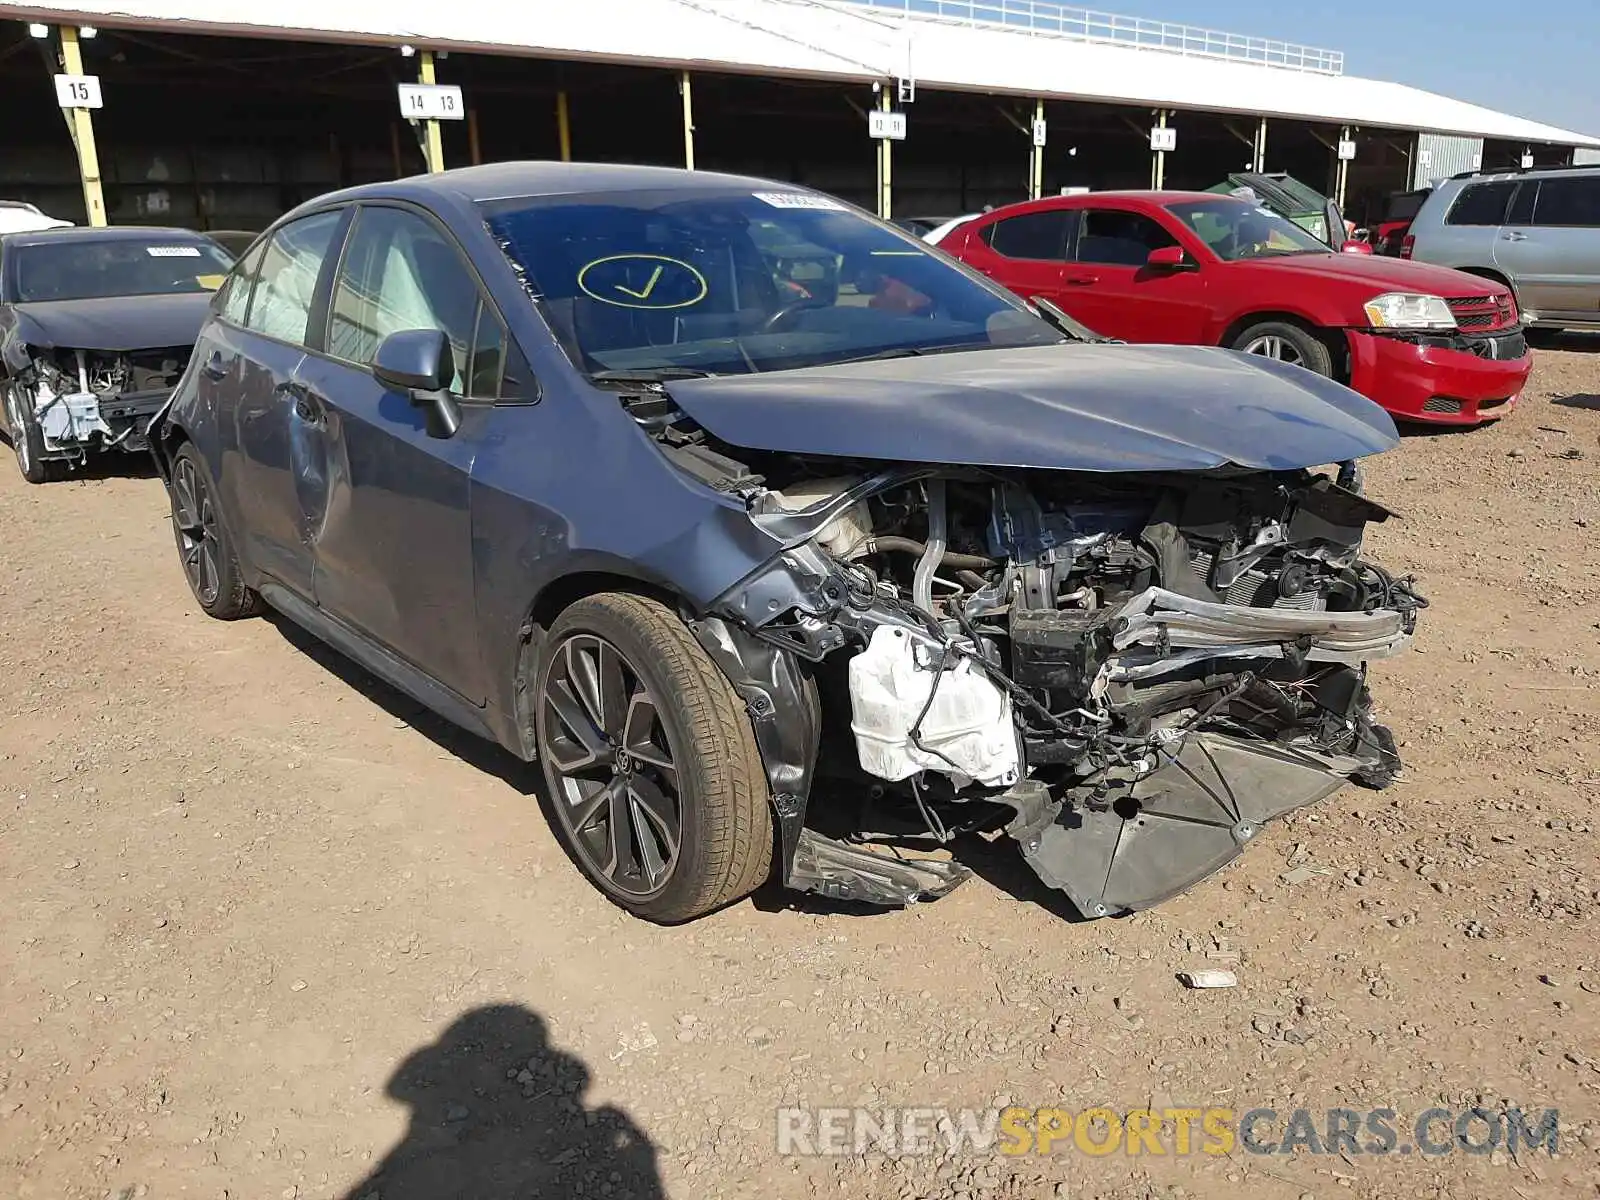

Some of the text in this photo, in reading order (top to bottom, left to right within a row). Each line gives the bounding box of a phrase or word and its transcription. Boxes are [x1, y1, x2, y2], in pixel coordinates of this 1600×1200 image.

[68, 82, 89, 100] 15
[409, 94, 454, 111] 14 13
